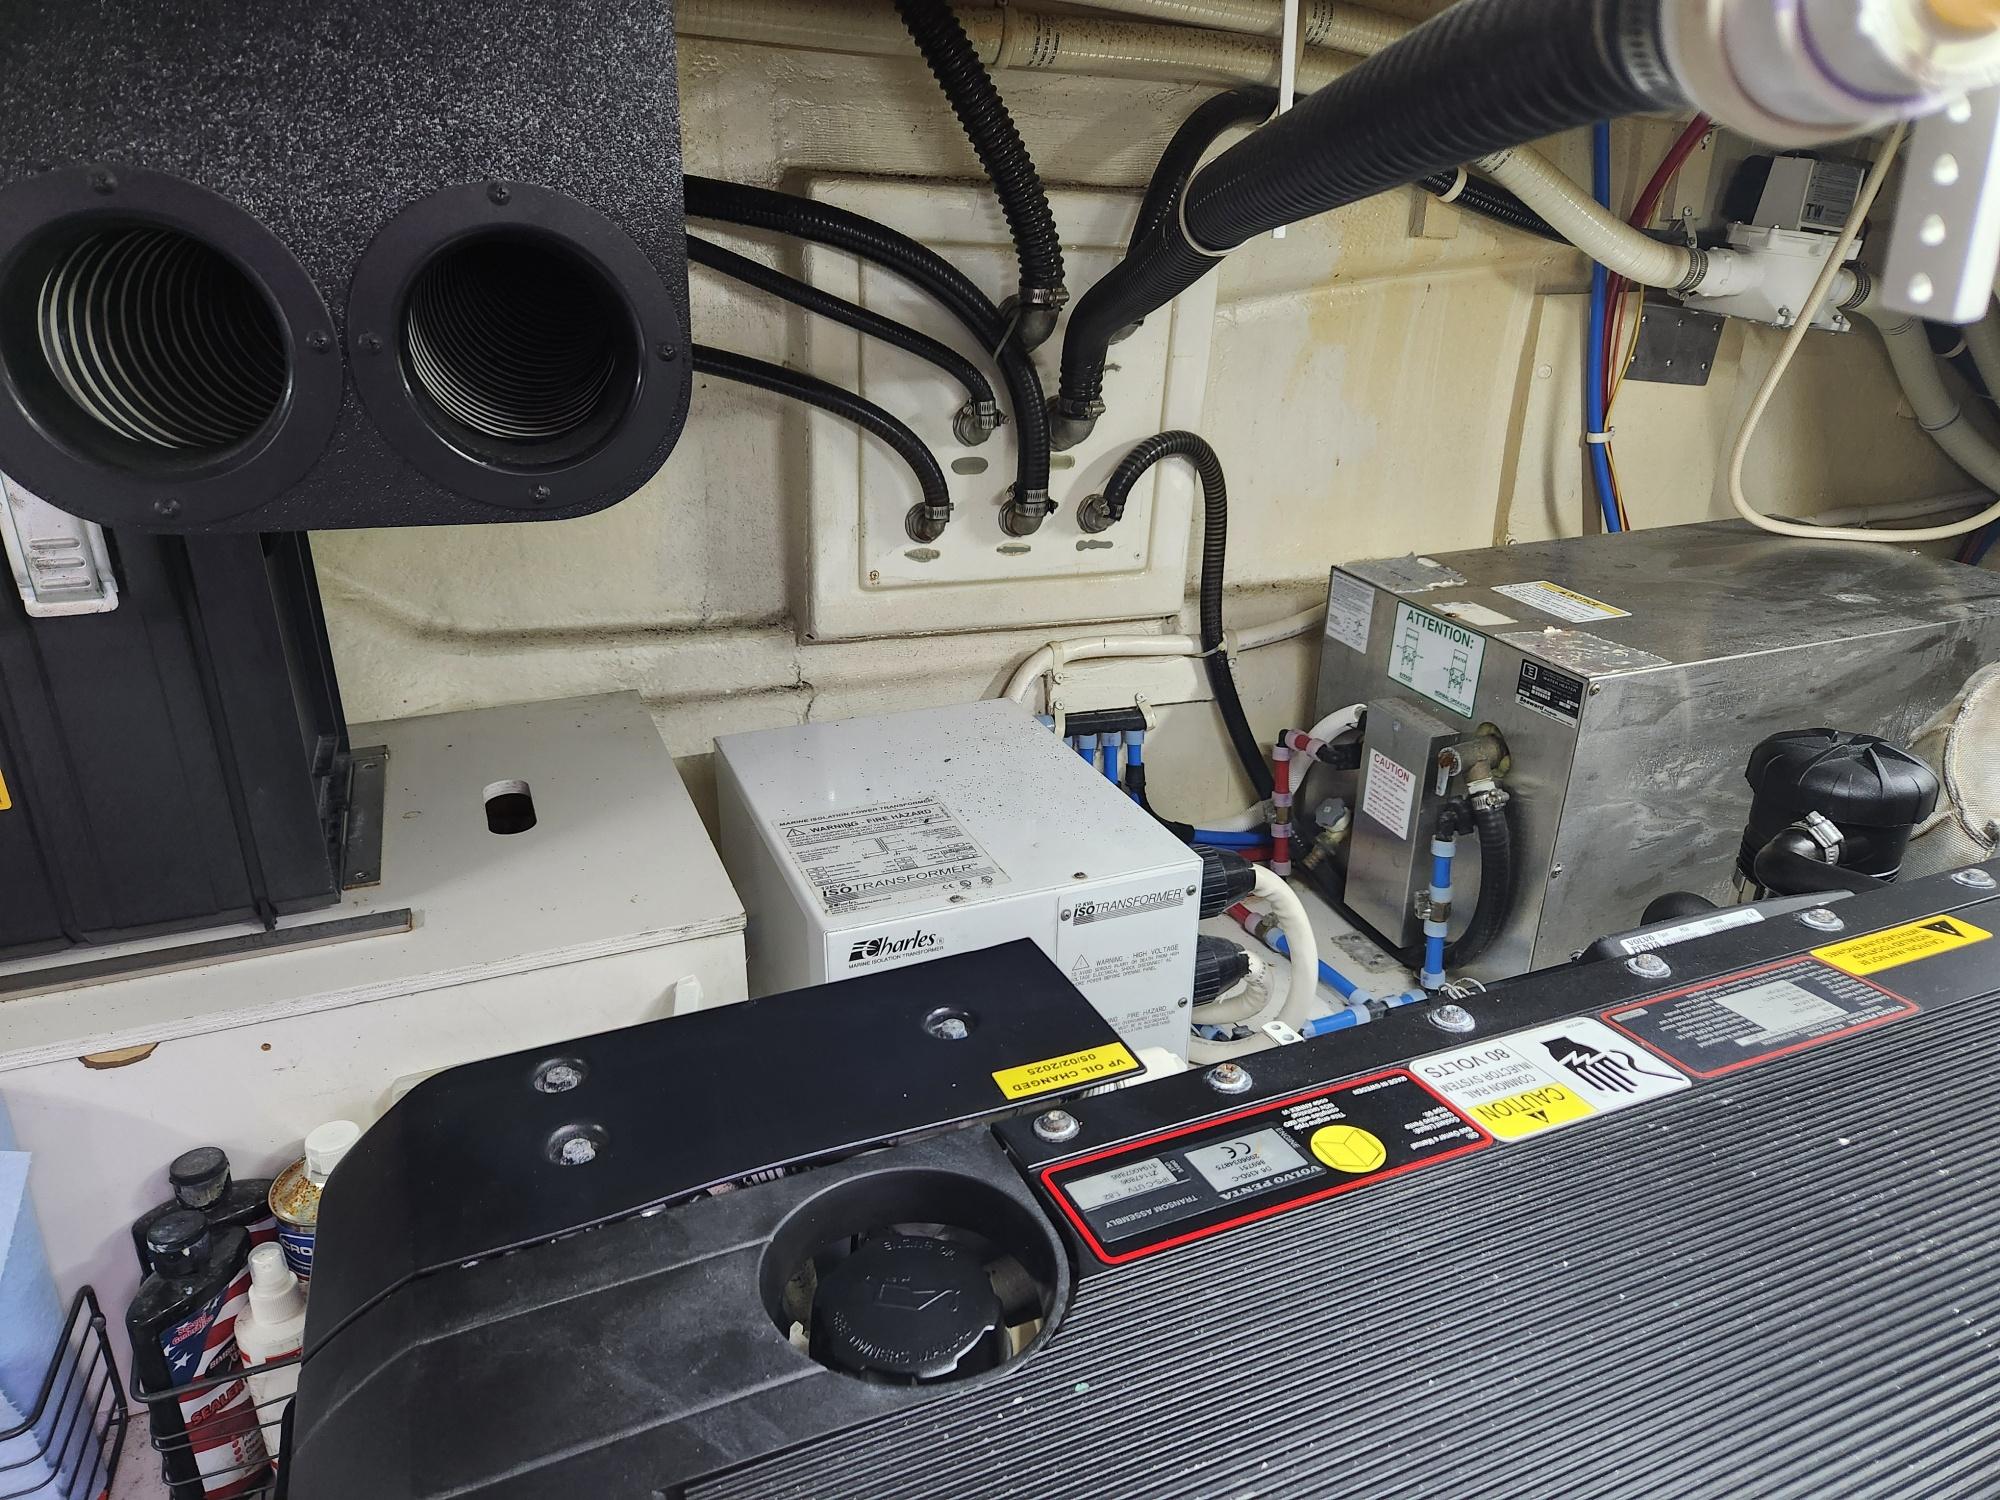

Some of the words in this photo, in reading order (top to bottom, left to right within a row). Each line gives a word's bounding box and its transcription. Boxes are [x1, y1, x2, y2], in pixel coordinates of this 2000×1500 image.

[1406, 610, 1474, 649] ATTENTION:
[1374, 753, 1410, 783] CAUTION
[808, 820, 860, 833] WARNING
[865, 815, 890, 824] FIRE
[889, 808, 933, 820] HAZARD
[851, 929, 937, 962] Charles
[1626, 935, 1654, 946] VOLVO
[1096, 955, 1124, 967] WARNING
[1133, 950, 1148, 958] HIGH
[1151, 944, 1179, 955] VOLTAGE
[1024, 1052, 1098, 1076] 05/02/2025
[1105, 1057, 1126, 1068] VP
[1481, 1047, 1512, 1062] 80
[1079, 1062, 1106, 1075] OIL
[1421, 1053, 1490, 1080] VOLTS
[1478, 1060, 1535, 1082] INJECTOR
[1010, 1069, 1080, 1092] CHANGED
[1437, 1074, 1486, 1093] SYSTEM
[1483, 1072, 1539, 1094] COMMON
[1459, 1086, 1491, 1100] RAIL
[1474, 1085, 1569, 1121] CAUTION
[1218, 1139, 1255, 1160] CE
[1268, 1162, 1324, 1185] VOLVO
[1216, 1178, 1274, 1202] PENTA
[1151, 1193, 1199, 1213] TRANSOM
[1101, 1206, 1155, 1229] ASSEMBLY
[191, 1380, 246, 1425] SEALER
